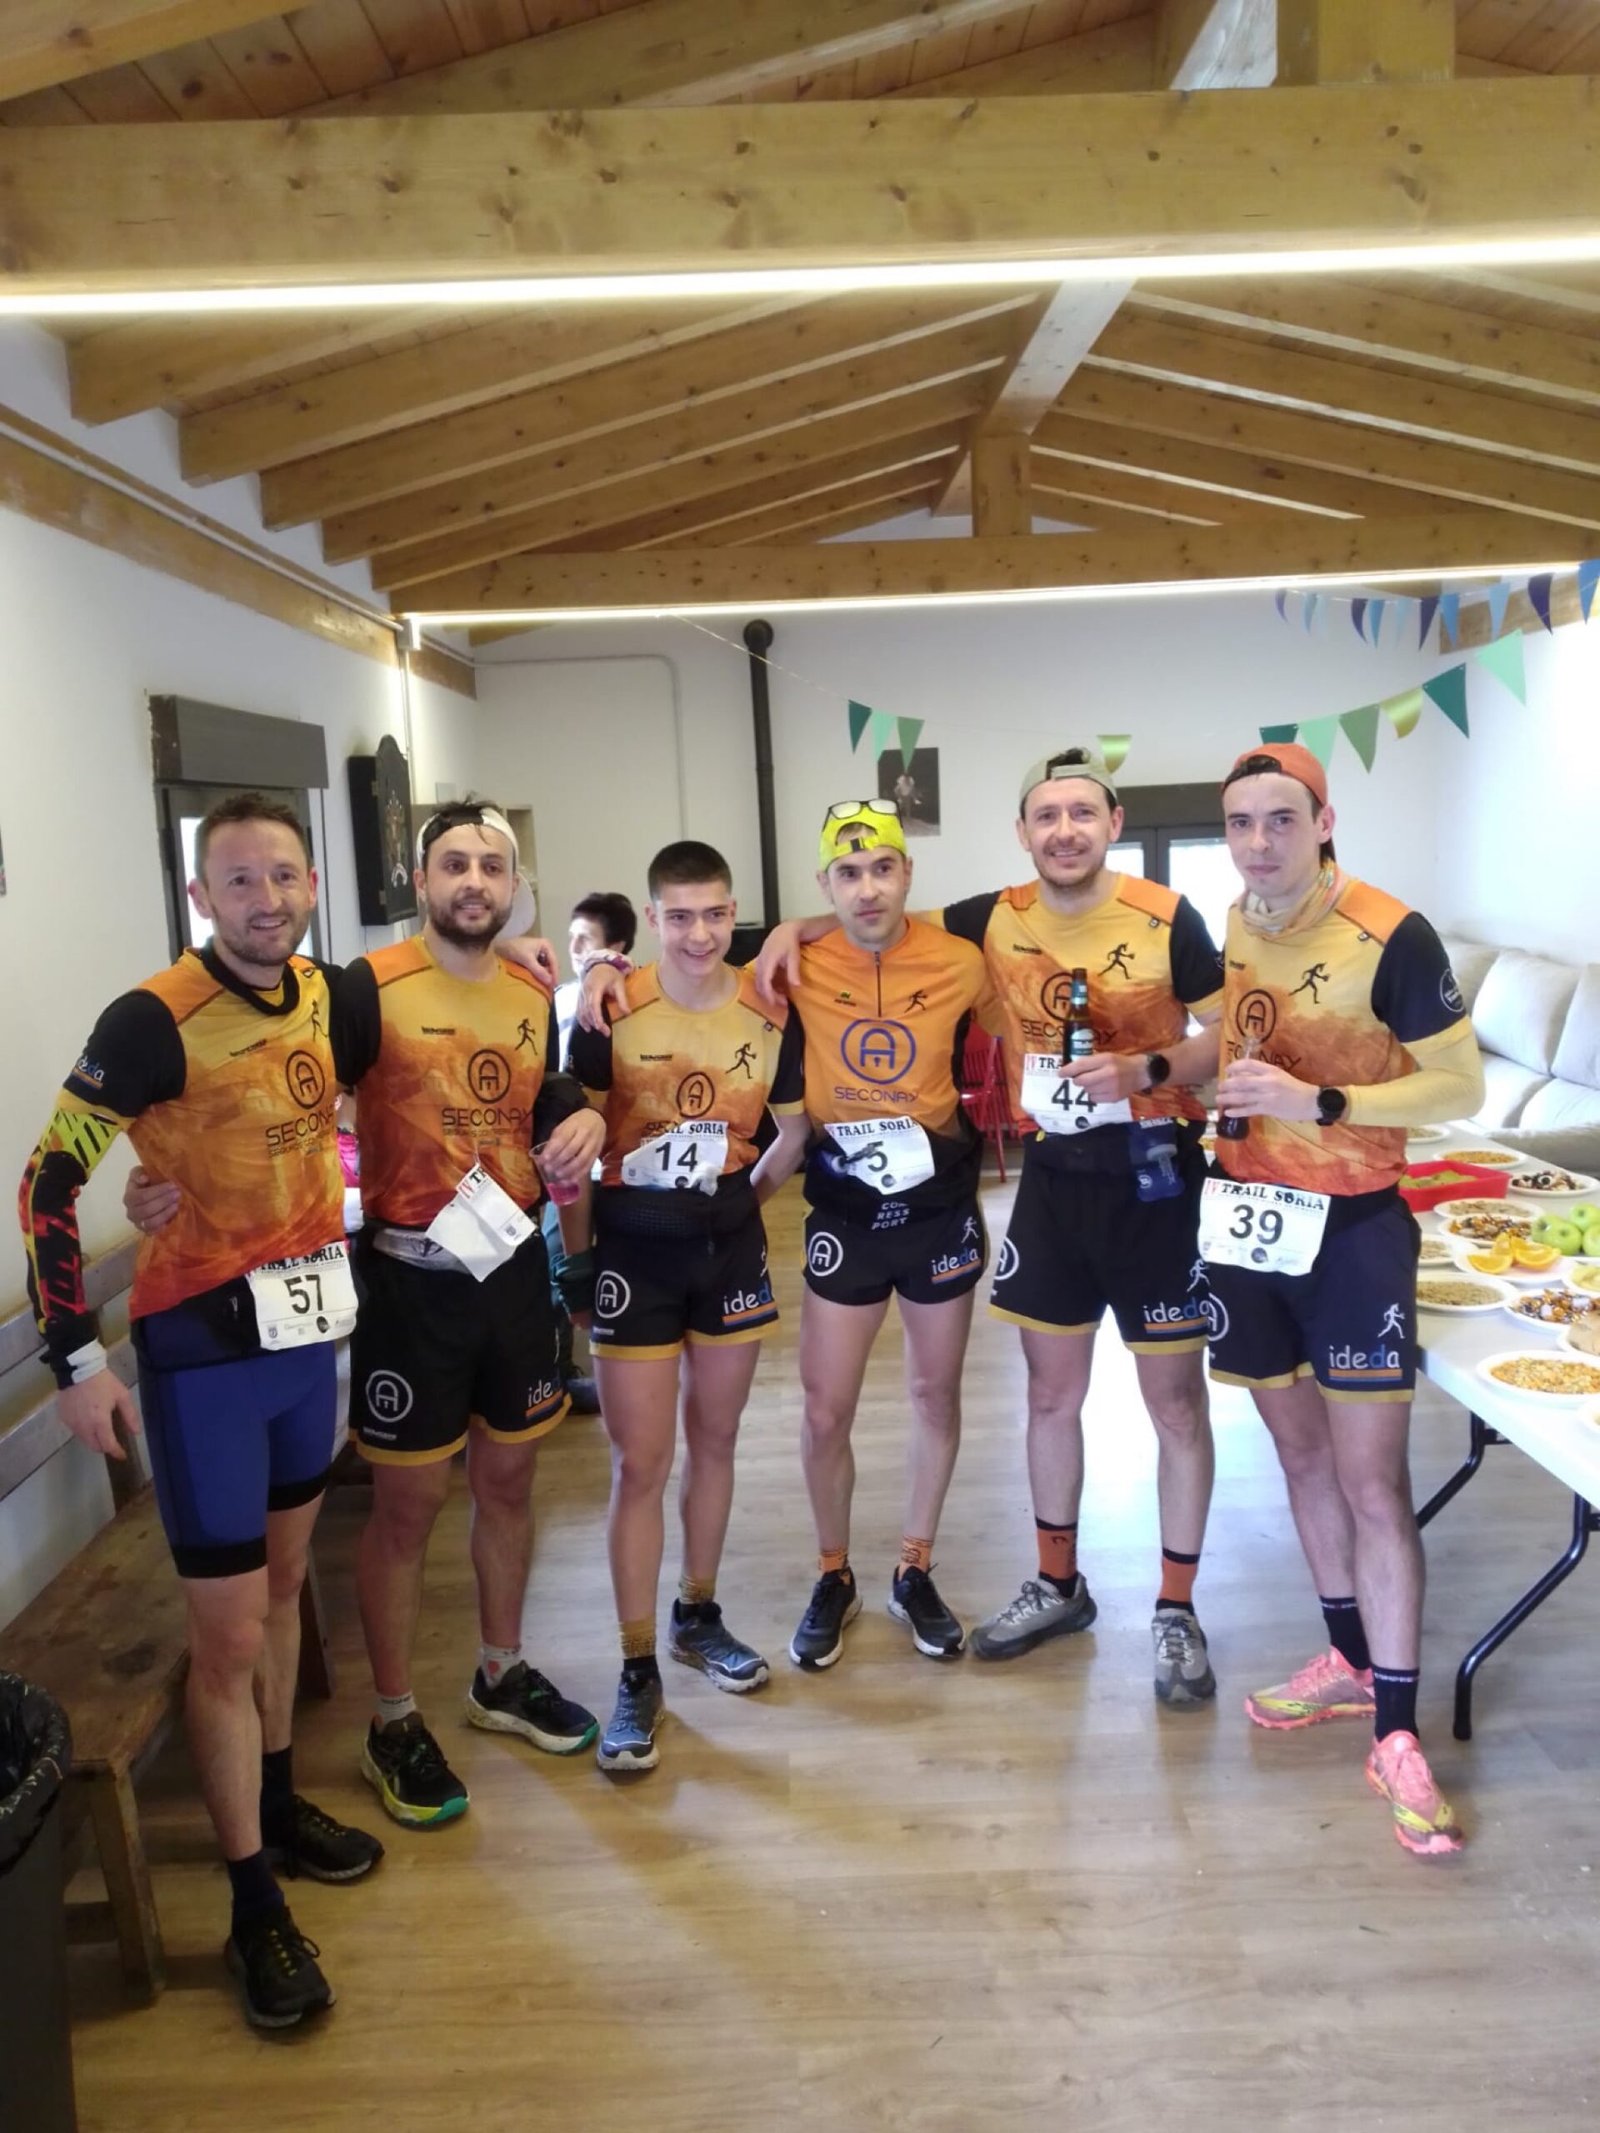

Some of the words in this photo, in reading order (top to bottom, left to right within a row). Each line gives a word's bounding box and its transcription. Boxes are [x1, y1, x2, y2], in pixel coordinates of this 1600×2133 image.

[1051, 1079, 1098, 1113] 44
[442, 1107, 533, 1127] SECONAY
[689, 1123, 725, 1135] SORIA
[837, 1123, 875, 1137] TRAIL
[655, 1141, 698, 1172] 14
[1221, 1183, 1268, 1199] TRAIL
[1273, 1190, 1325, 1211] SORIA
[871, 1217, 908, 1230] PORT
[1228, 1204, 1284, 1245] 39
[932, 1248, 979, 1275] ideda
[284, 1274, 323, 1314] 57
[1329, 1343, 1401, 1369] ideda
